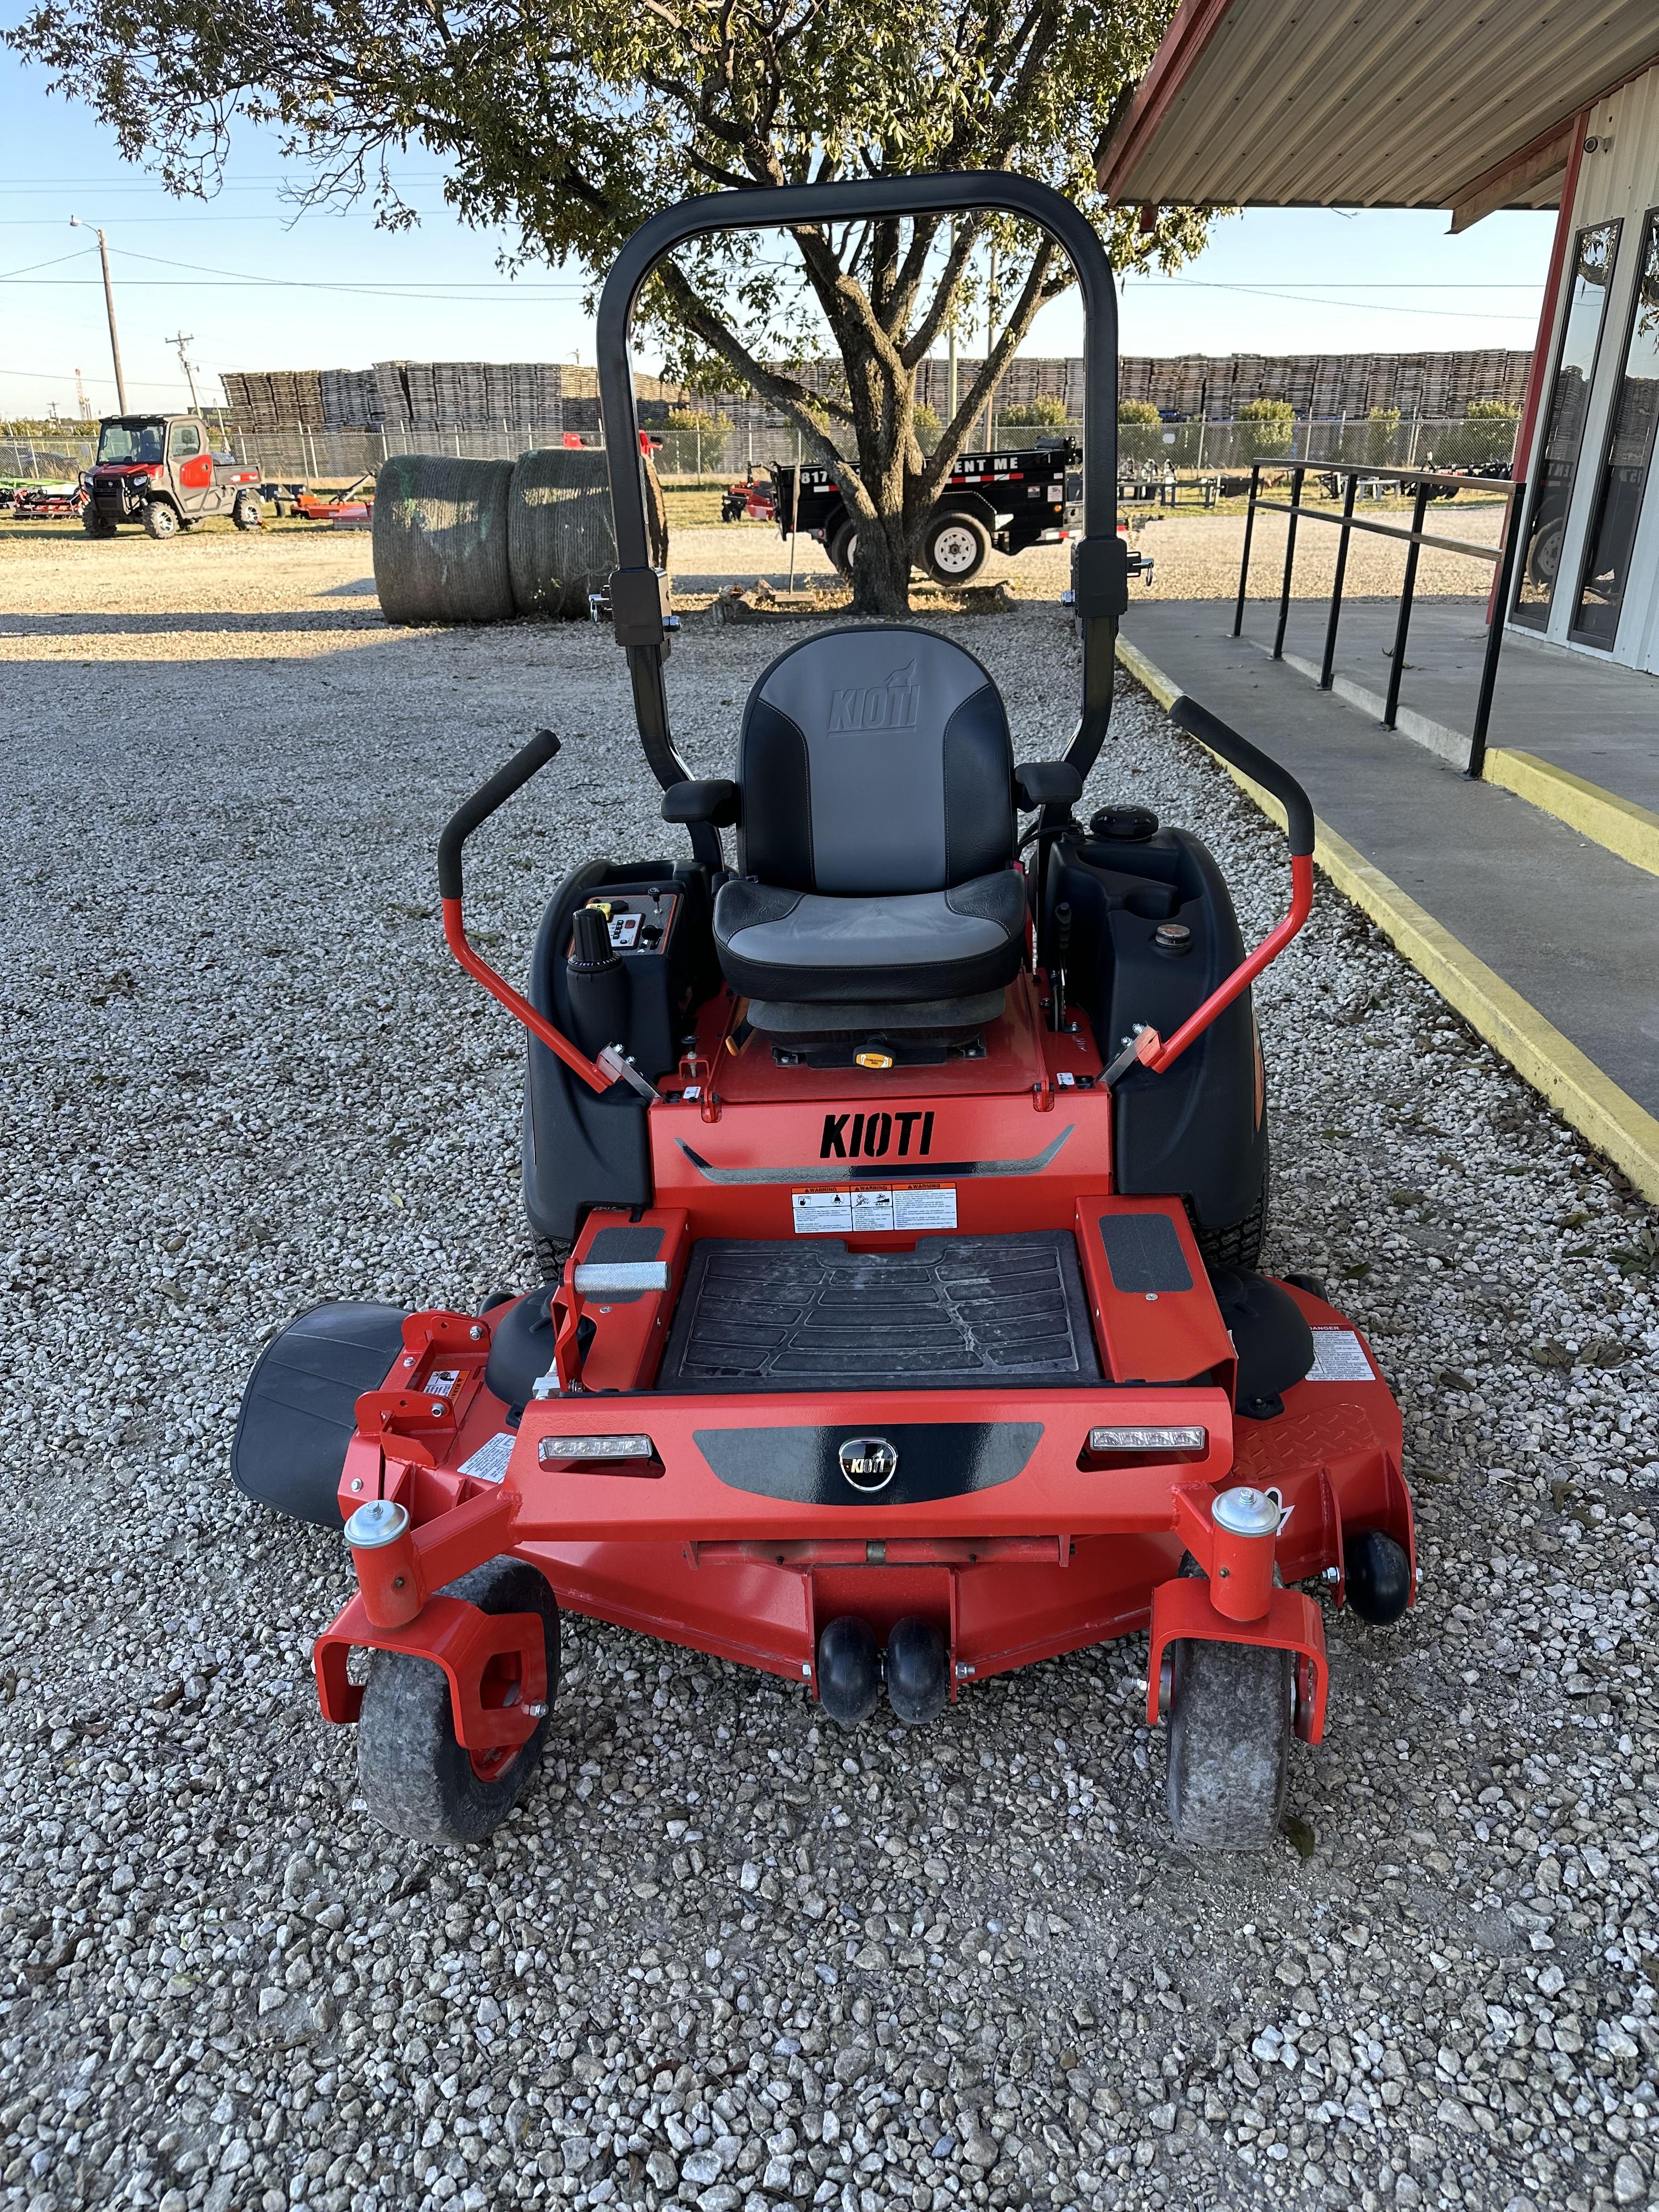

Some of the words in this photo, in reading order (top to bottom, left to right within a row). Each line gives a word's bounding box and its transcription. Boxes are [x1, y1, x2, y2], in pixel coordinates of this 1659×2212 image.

[954, 459, 986, 473] ENT
[994, 457, 1018, 470] ME
[800, 471, 828, 484] 817
[828, 684, 921, 730] KIOTI
[820, 1111, 935, 1159] KIOTI
[851, 1458, 885, 1473] KIOTI
